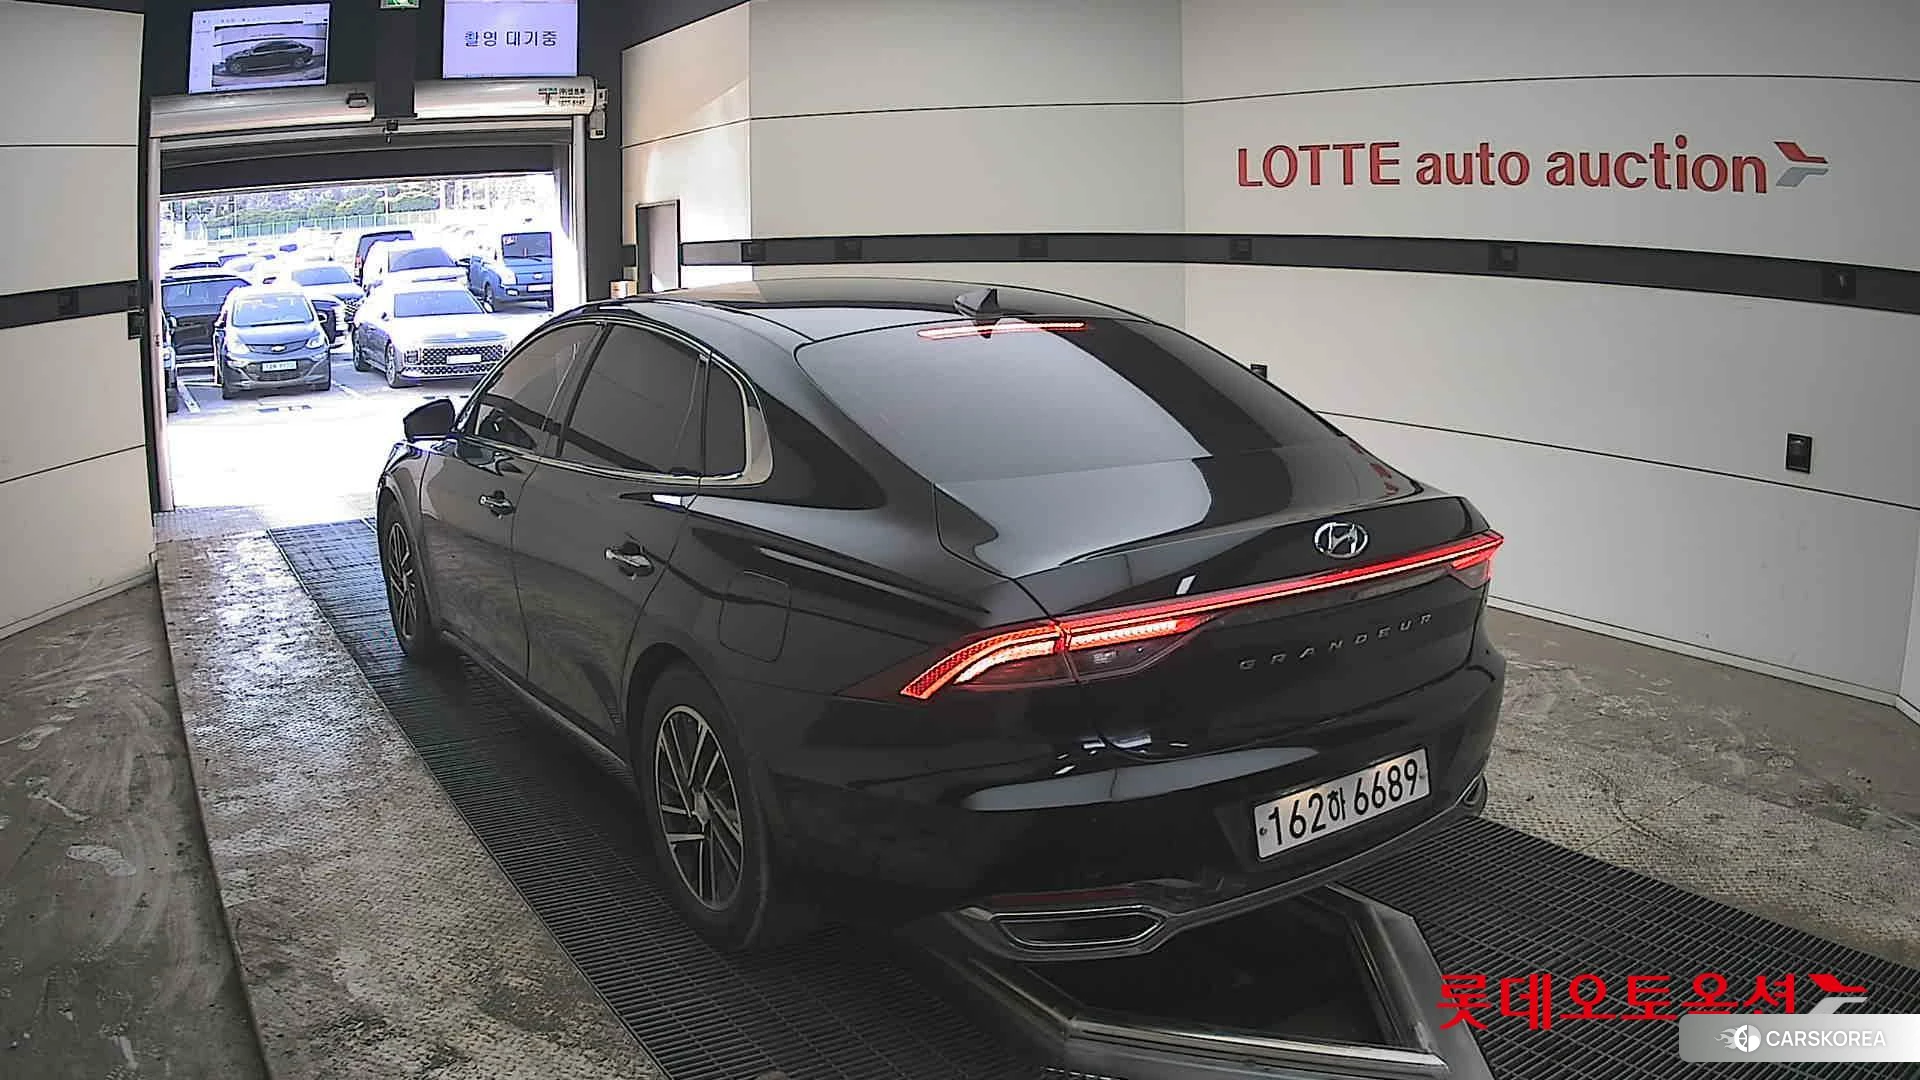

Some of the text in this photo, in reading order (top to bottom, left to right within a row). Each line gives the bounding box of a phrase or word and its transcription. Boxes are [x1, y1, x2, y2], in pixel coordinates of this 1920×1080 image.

[506, 31, 557, 47] 대기중
[1237, 134, 1766, 193] LOTTE auto auction
[1239, 614, 1432, 670] GRANDEUR
[1268, 758, 1418, 845] 162하 6689
